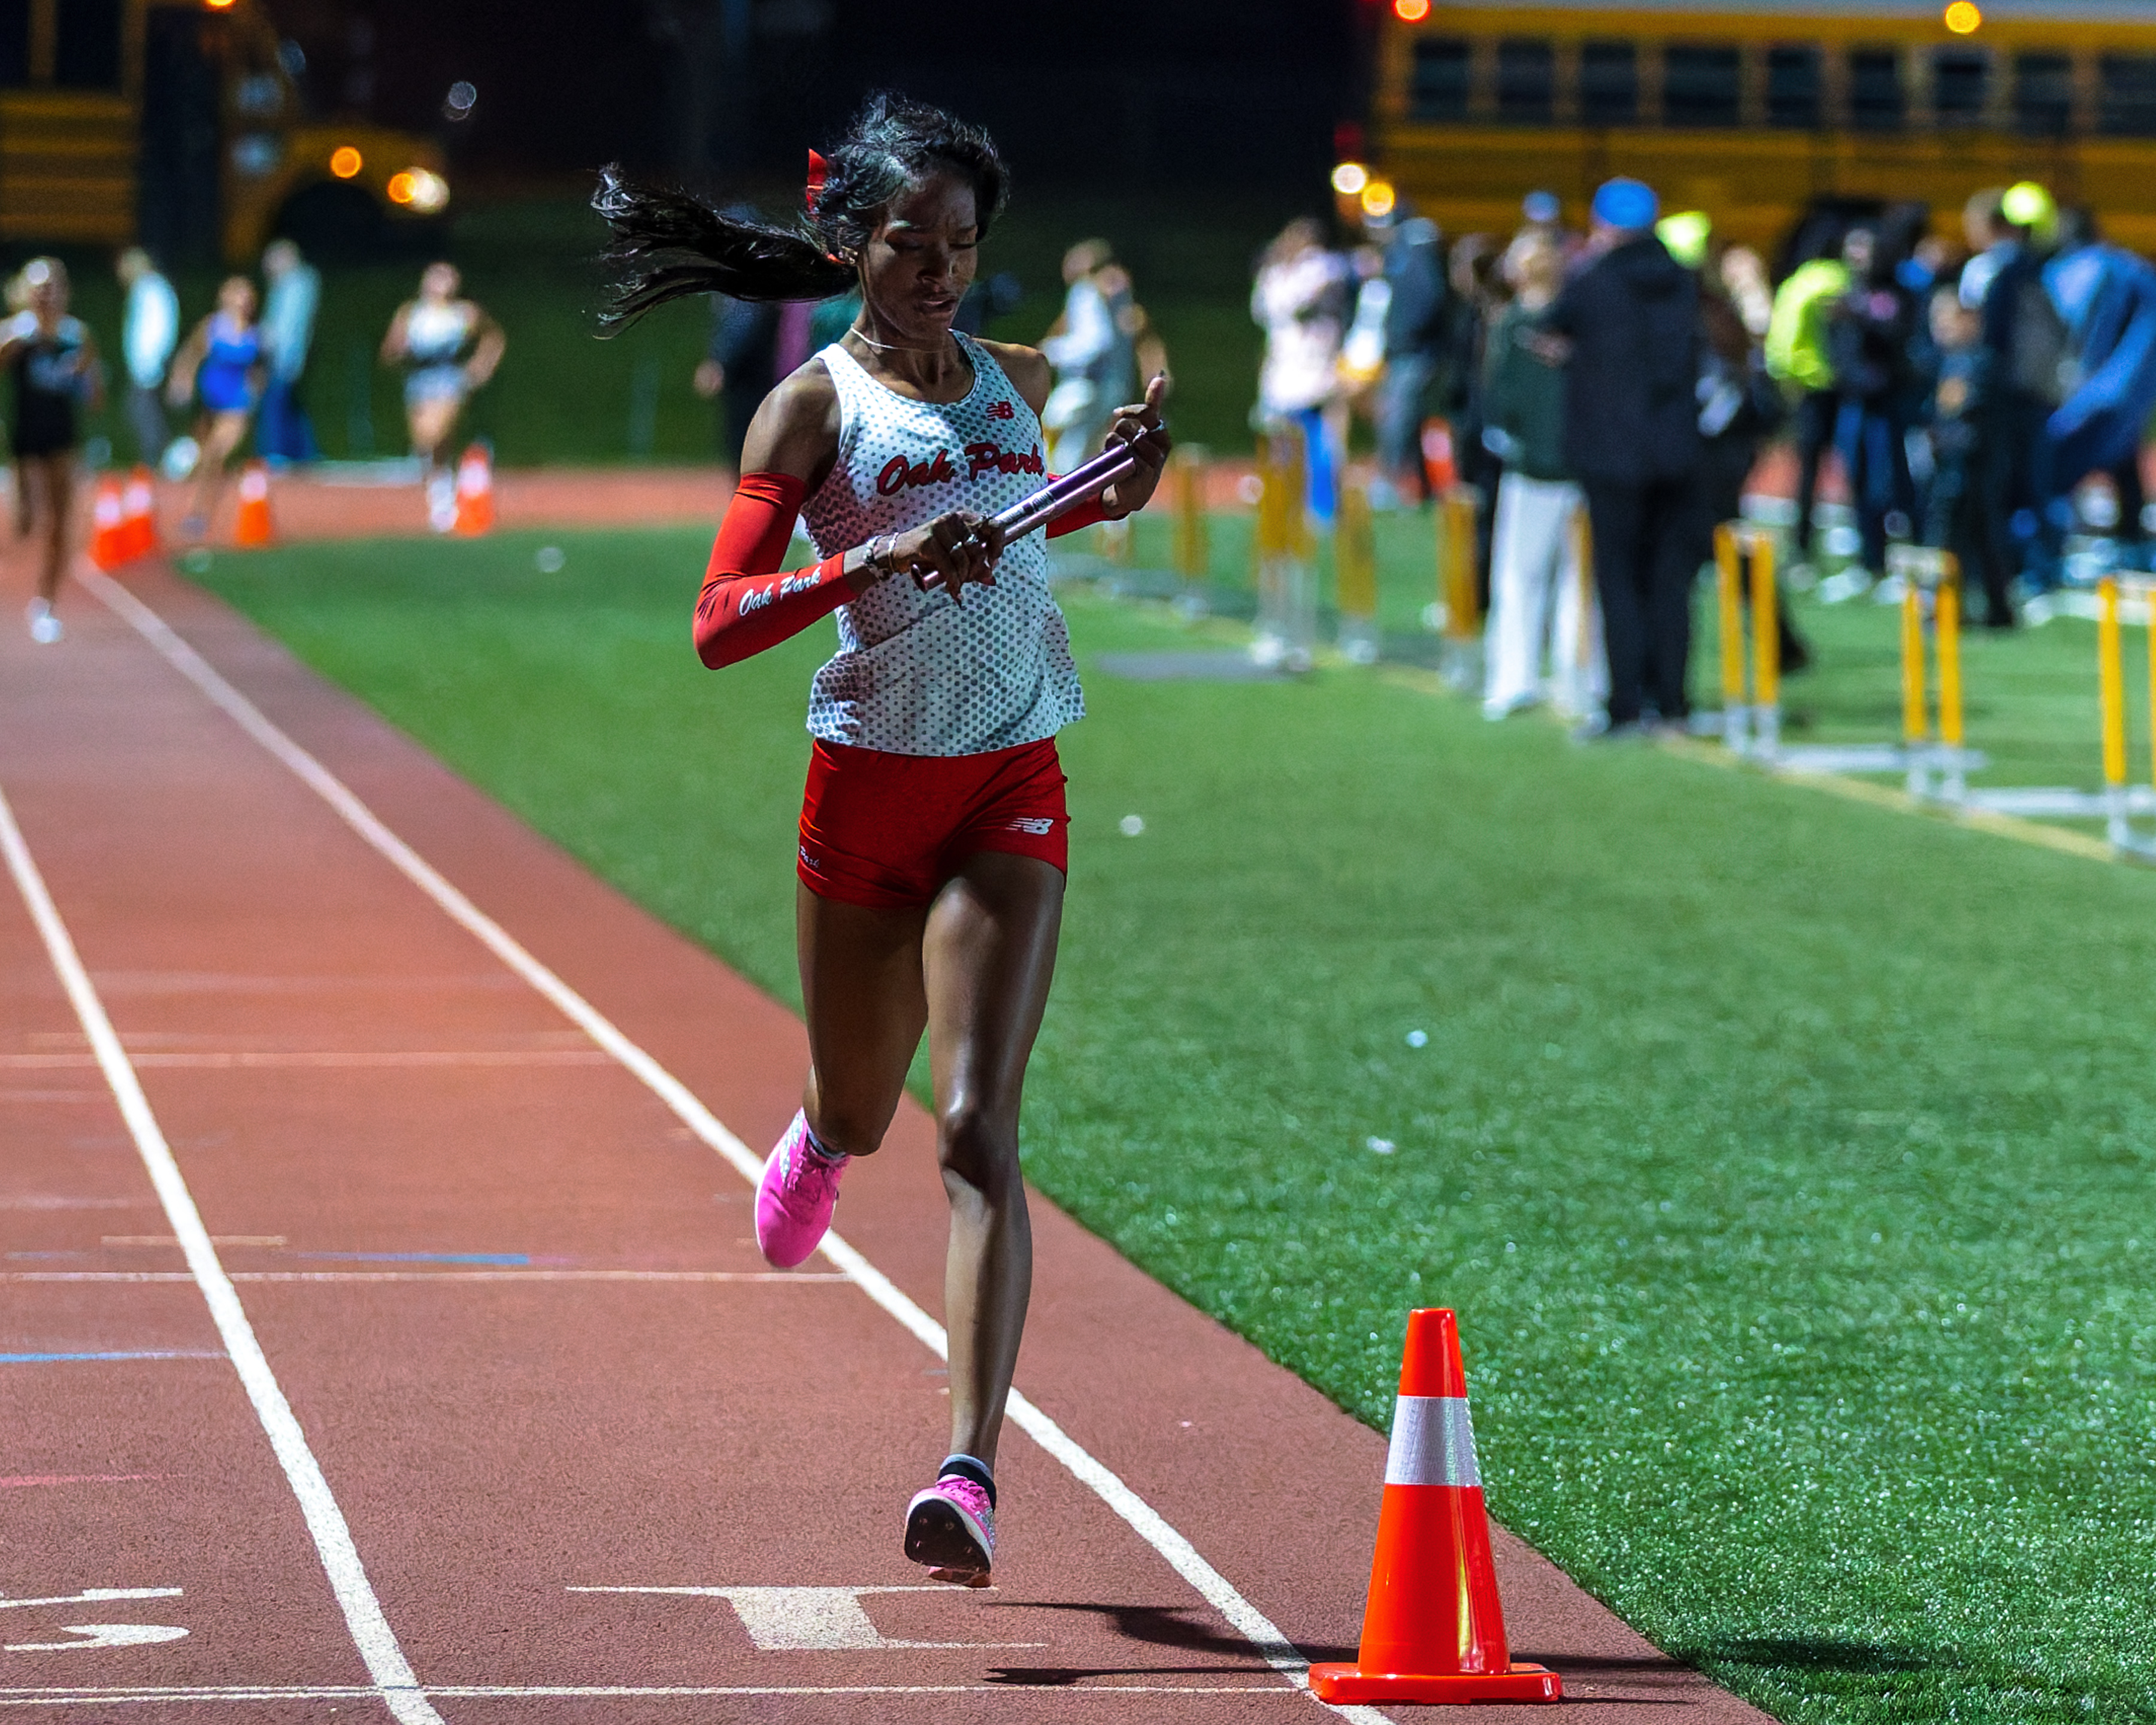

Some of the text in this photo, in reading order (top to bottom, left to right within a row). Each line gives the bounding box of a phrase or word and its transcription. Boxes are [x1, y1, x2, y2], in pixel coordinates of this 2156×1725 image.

[877, 442, 1044, 496] Oak Park
[738, 566, 822, 617] Oak Park
